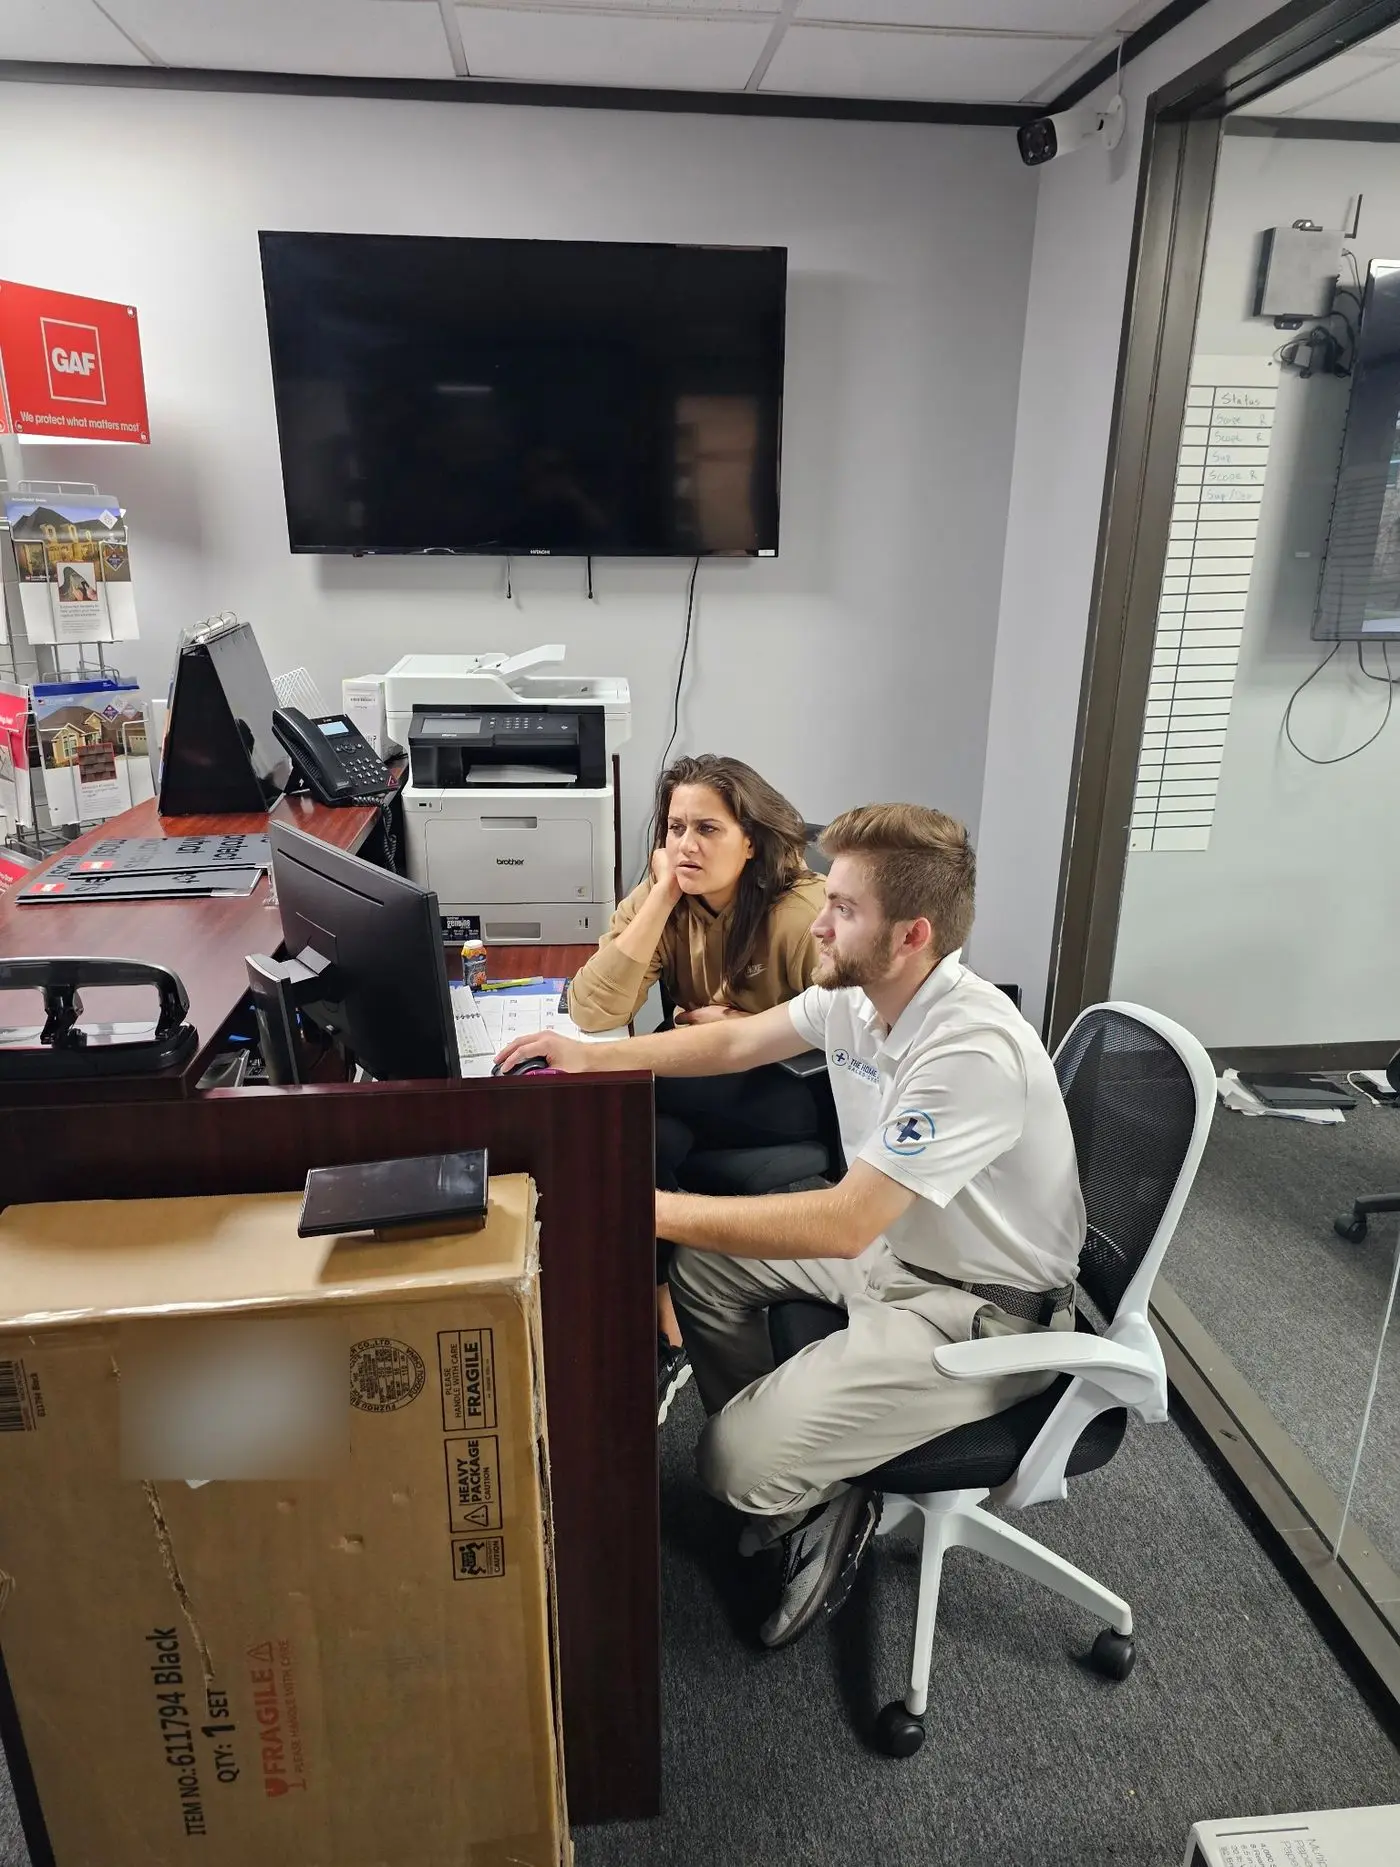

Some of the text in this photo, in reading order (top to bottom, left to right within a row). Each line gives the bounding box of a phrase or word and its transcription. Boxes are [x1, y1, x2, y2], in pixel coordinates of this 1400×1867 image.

[52, 348, 95, 376] GAF
[1221, 392, 1260, 406] Status
[20, 410, 140, 432] We protect what matters most
[496, 858, 524, 866] brother
[850, 1058, 877, 1077] THE HOME
[406, 1347, 423, 1370] CHINA
[450, 1343, 462, 1418] HANDLE WITH CARE
[464, 1342, 481, 1417] FRAGILE
[457, 1458, 470, 1503] HEAVY
[468, 1439, 482, 1502] PACKAGE
[483, 1466, 492, 1501] CAUTION
[493, 1540, 501, 1573] CAUTION
[145, 1627, 183, 1685] Black
[251, 1668, 287, 1775] FRAGILE
[278, 1639, 305, 1774] PLEASE HANDLE WITH CARE
[201, 1689, 240, 1783] QTY: 1 SET
[182, 1802, 206, 1836] ITEM
